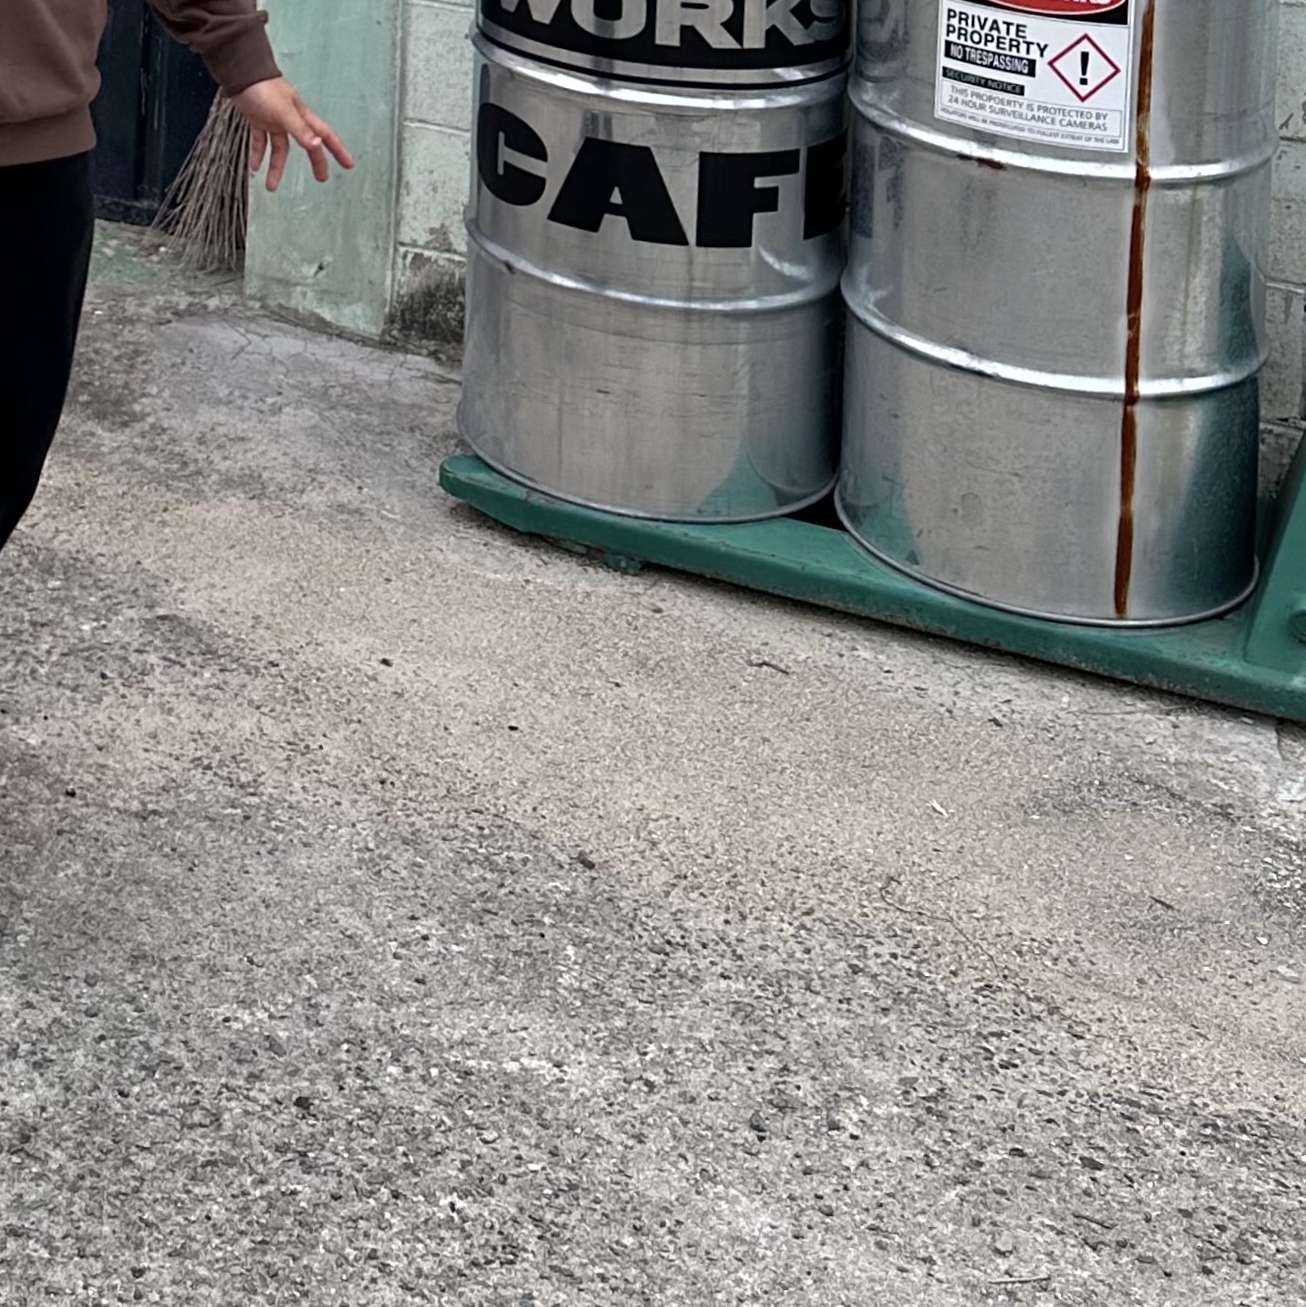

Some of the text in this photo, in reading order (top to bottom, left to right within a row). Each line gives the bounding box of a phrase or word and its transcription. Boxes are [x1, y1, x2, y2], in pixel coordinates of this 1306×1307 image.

[947, 8, 1027, 39] PRIVATE
[946, 23, 1048, 58] PROPERTY
[950, 43, 1029, 74] NO TRESPASSING
[946, 68, 1021, 93] SECURITY NOTICE
[948, 94, 959, 104] 24
[961, 98, 987, 111] HOUR
[989, 104, 1056, 126] SURVEILLANCE
[1059, 118, 1107, 131] CAMERAS
[951, 84, 969, 97] THIS
[1026, 103, 1035, 112] IS
[1037, 104, 1093, 120] PROTECTED
[1095, 112, 1108, 121] BY
